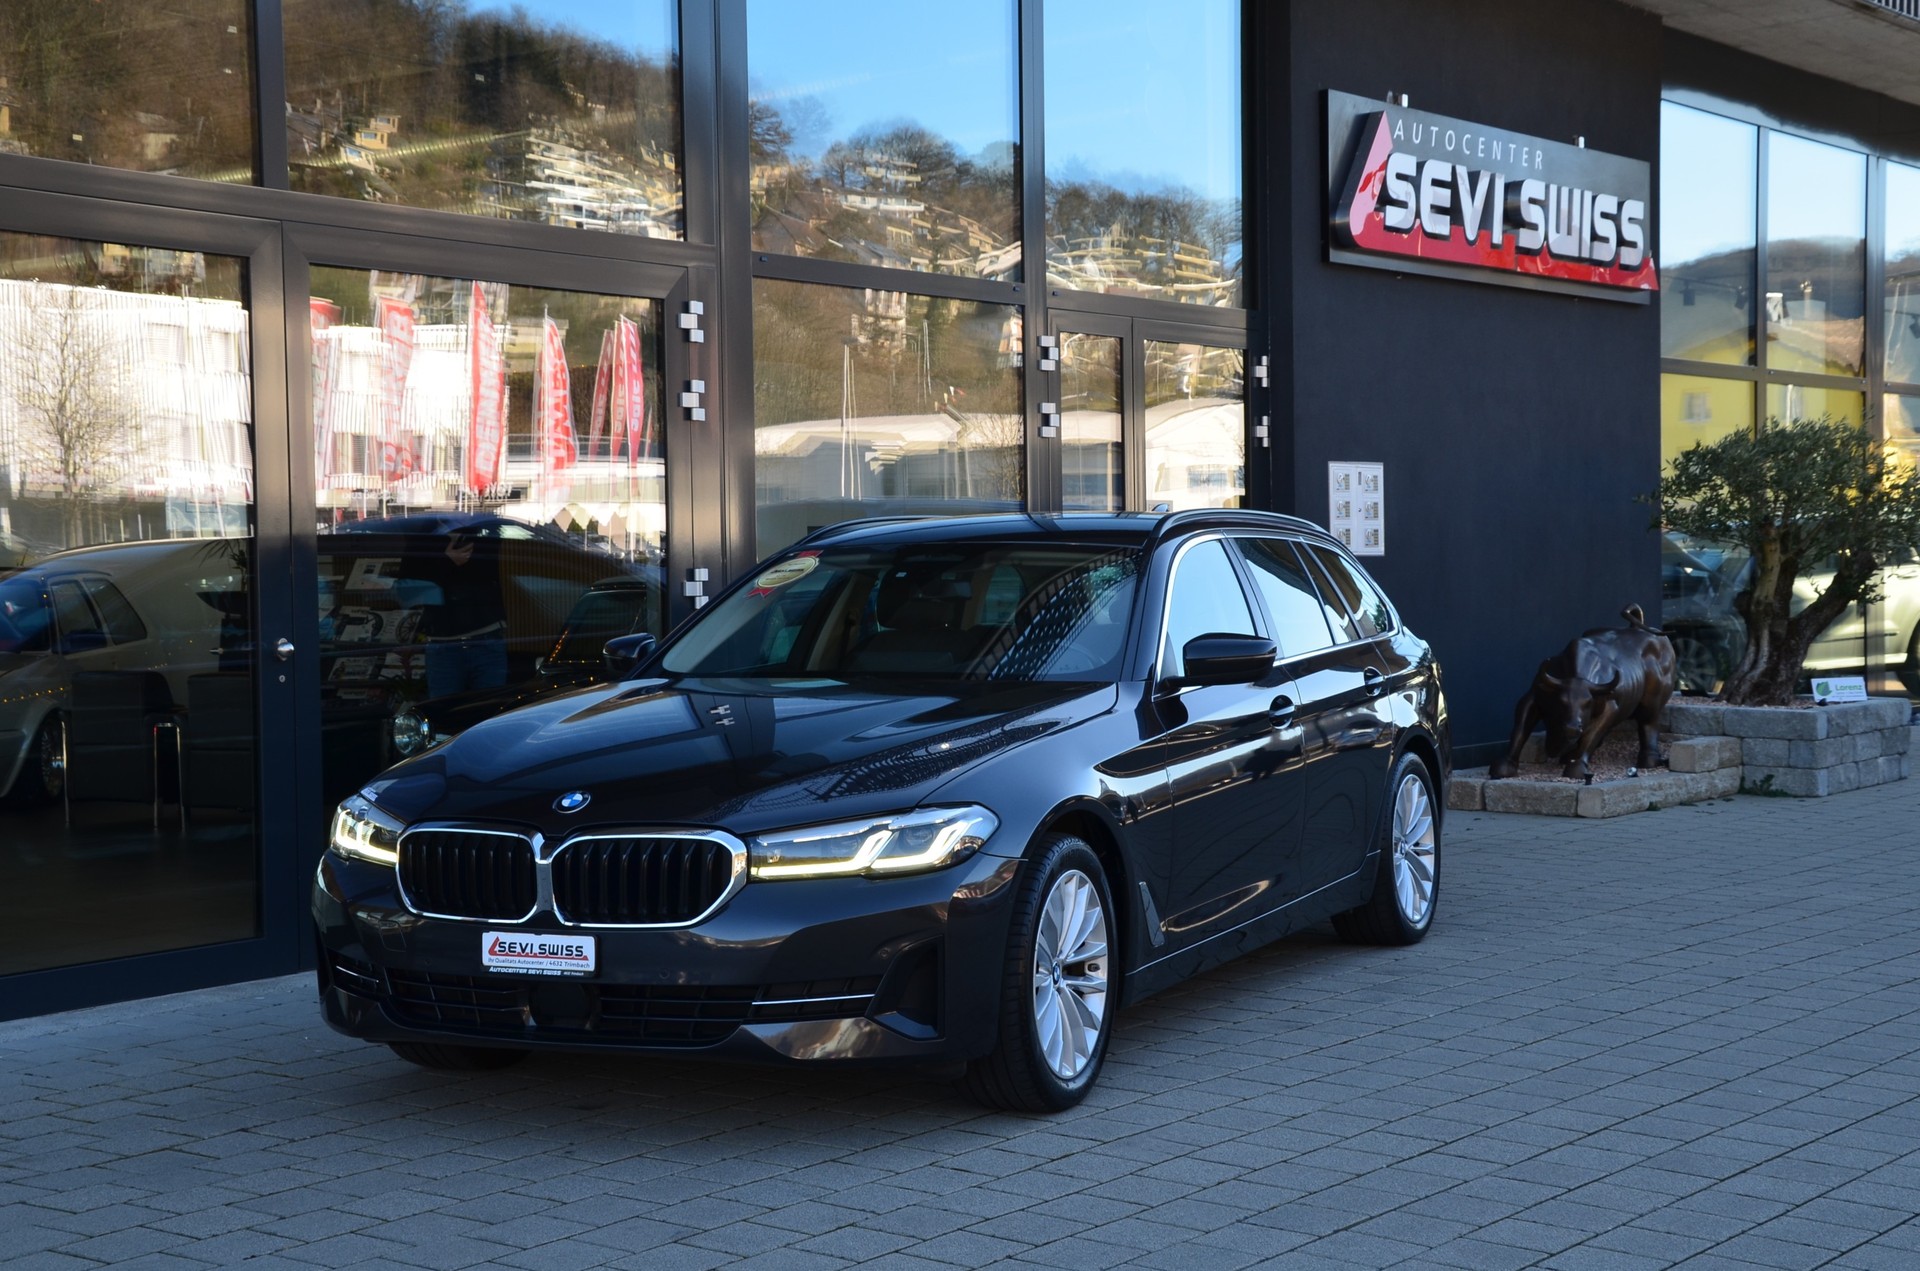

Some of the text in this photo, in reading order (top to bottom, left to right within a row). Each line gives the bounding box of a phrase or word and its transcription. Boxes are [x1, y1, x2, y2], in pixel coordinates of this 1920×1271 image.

[1393, 118, 1545, 171] AUTOCENTER
[1384, 151, 1646, 268] SEVI SWISS
[497, 941, 584, 957] SEVI SWISS
[518, 958, 545, 966] Autocenter
[564, 961, 591, 969] Trimbach
